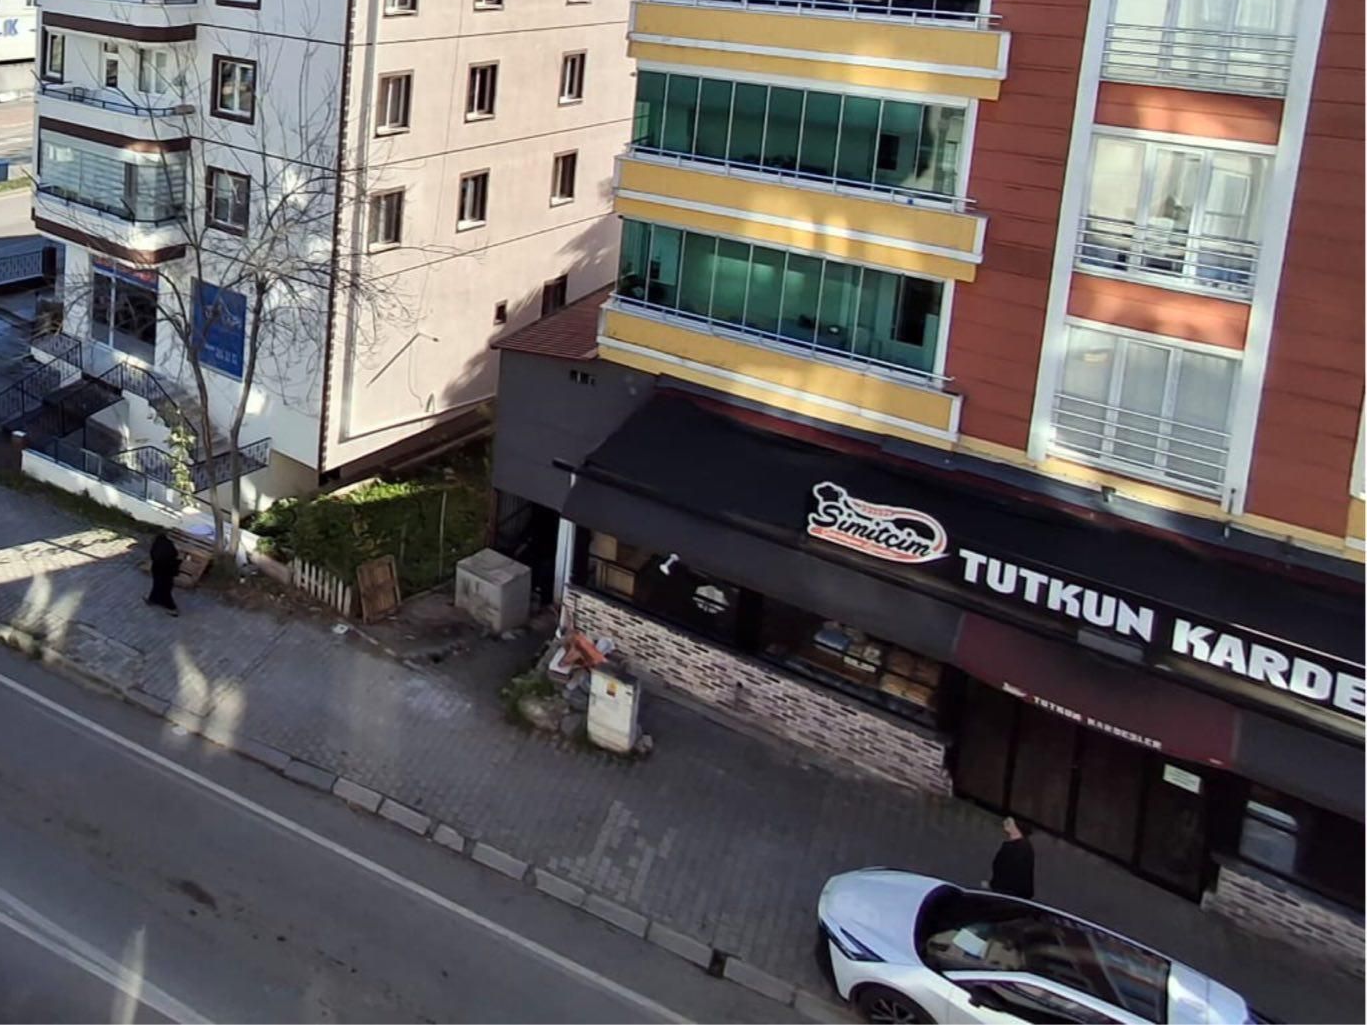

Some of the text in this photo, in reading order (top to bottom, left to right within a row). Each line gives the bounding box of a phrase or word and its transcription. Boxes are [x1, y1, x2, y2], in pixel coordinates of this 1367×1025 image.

[959, 548, 1366, 717] TUTKUN KARDE
[1034, 695, 1083, 722] TUTKUN
